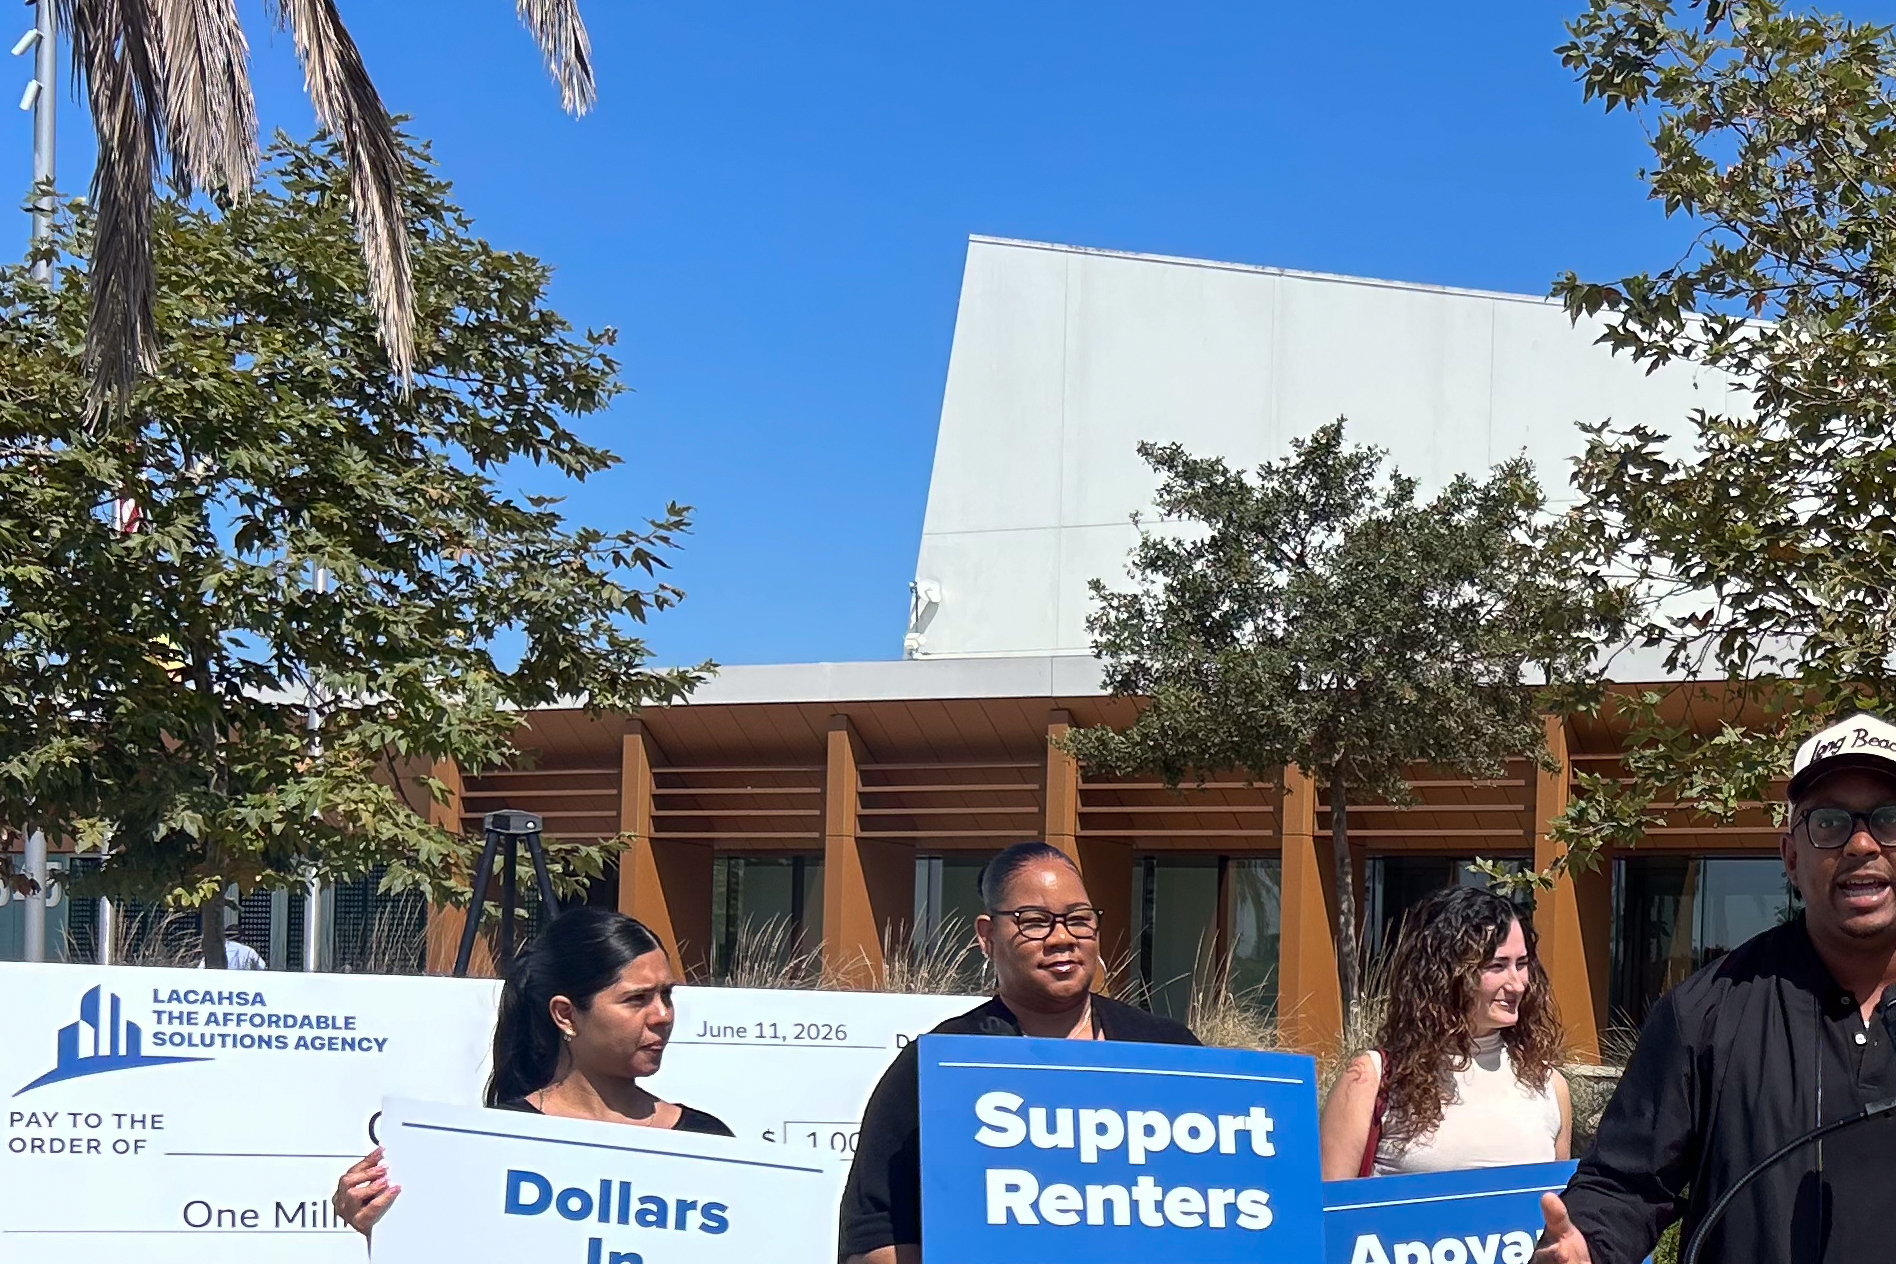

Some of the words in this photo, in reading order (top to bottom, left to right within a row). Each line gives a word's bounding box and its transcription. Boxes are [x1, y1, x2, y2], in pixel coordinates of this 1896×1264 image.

[1809, 735, 1847, 765] Long
[152, 988, 267, 1008] LACAHSA
[152, 1010, 200, 1028] THE
[204, 1012, 357, 1032] AFFORDABLE
[696, 1020, 748, 1039] June
[754, 1022, 787, 1042] 11,
[793, 1022, 848, 1041] 2026
[151, 1031, 289, 1050] SOLUTIONS
[294, 1035, 389, 1053] AGENCY
[10, 1111, 60, 1130] PAY
[67, 1112, 103, 1130] TO
[112, 1112, 165, 1131] THE
[974, 1090, 1277, 1165] Support
[8, 1136, 102, 1155] ORDER
[112, 1138, 148, 1155] OF
[504, 1168, 730, 1235] Dollars
[985, 1168, 1274, 1231] Renters
[183, 1200, 260, 1229] One
[275, 1199, 348, 1229] Mill
